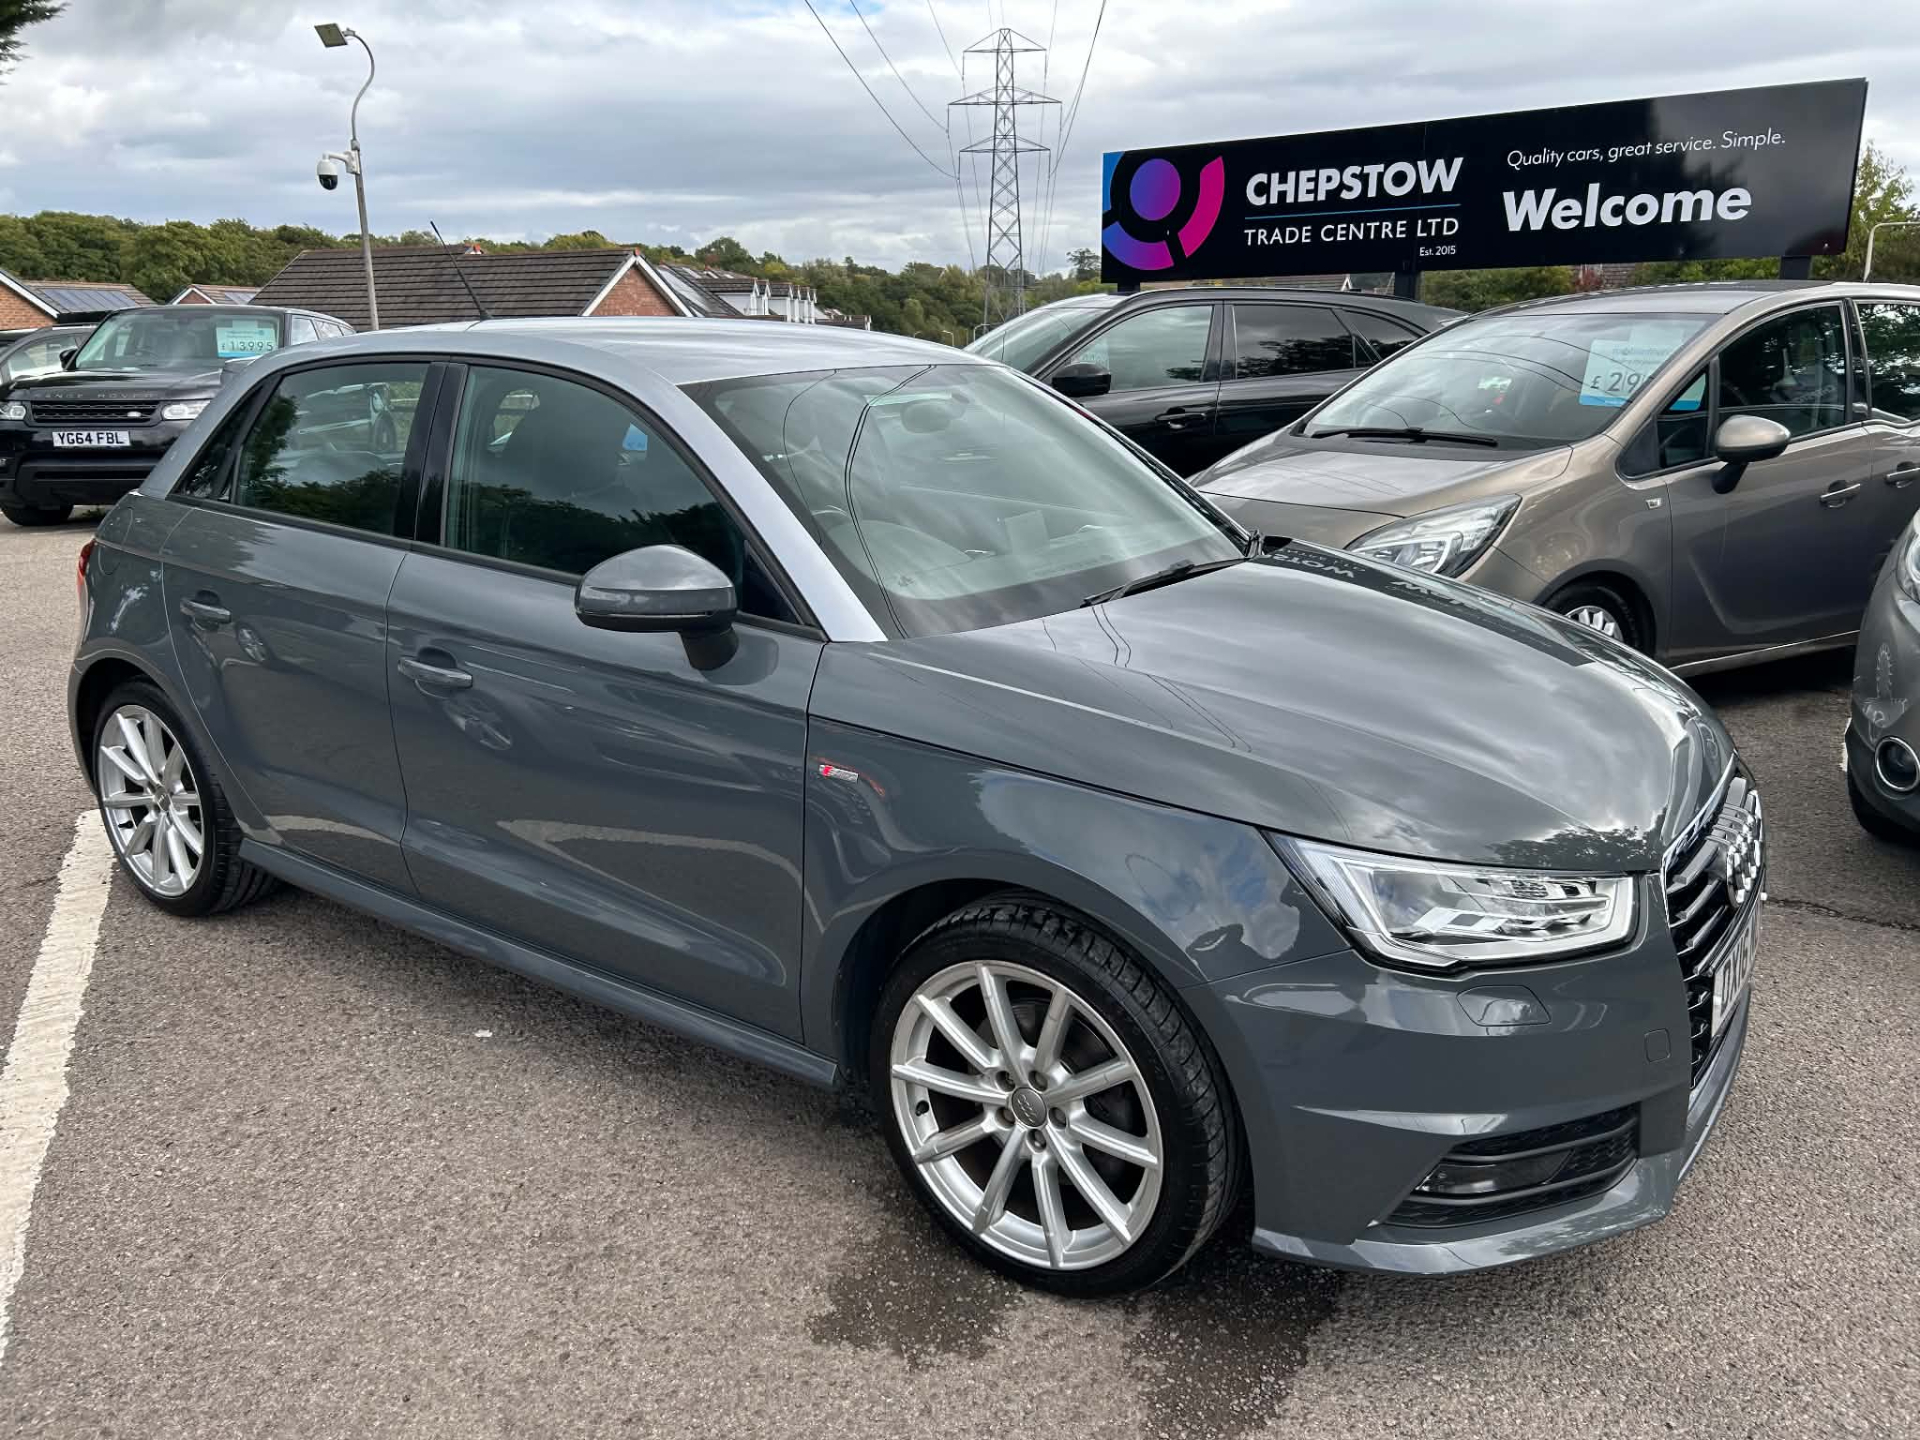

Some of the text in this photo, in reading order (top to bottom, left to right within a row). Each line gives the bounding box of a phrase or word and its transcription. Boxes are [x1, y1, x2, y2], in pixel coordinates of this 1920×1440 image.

[1508, 127, 1786, 170] Quality cars, great service. Simple.
[1246, 157, 1464, 206] CHEPSTOW
[1502, 183, 1752, 232] Welcome
[1243, 217, 1459, 246] TRADE CENTRE LTD
[1419, 245, 1456, 257] Est. 2015
[58, 432, 125, 445] YG64 FBL
